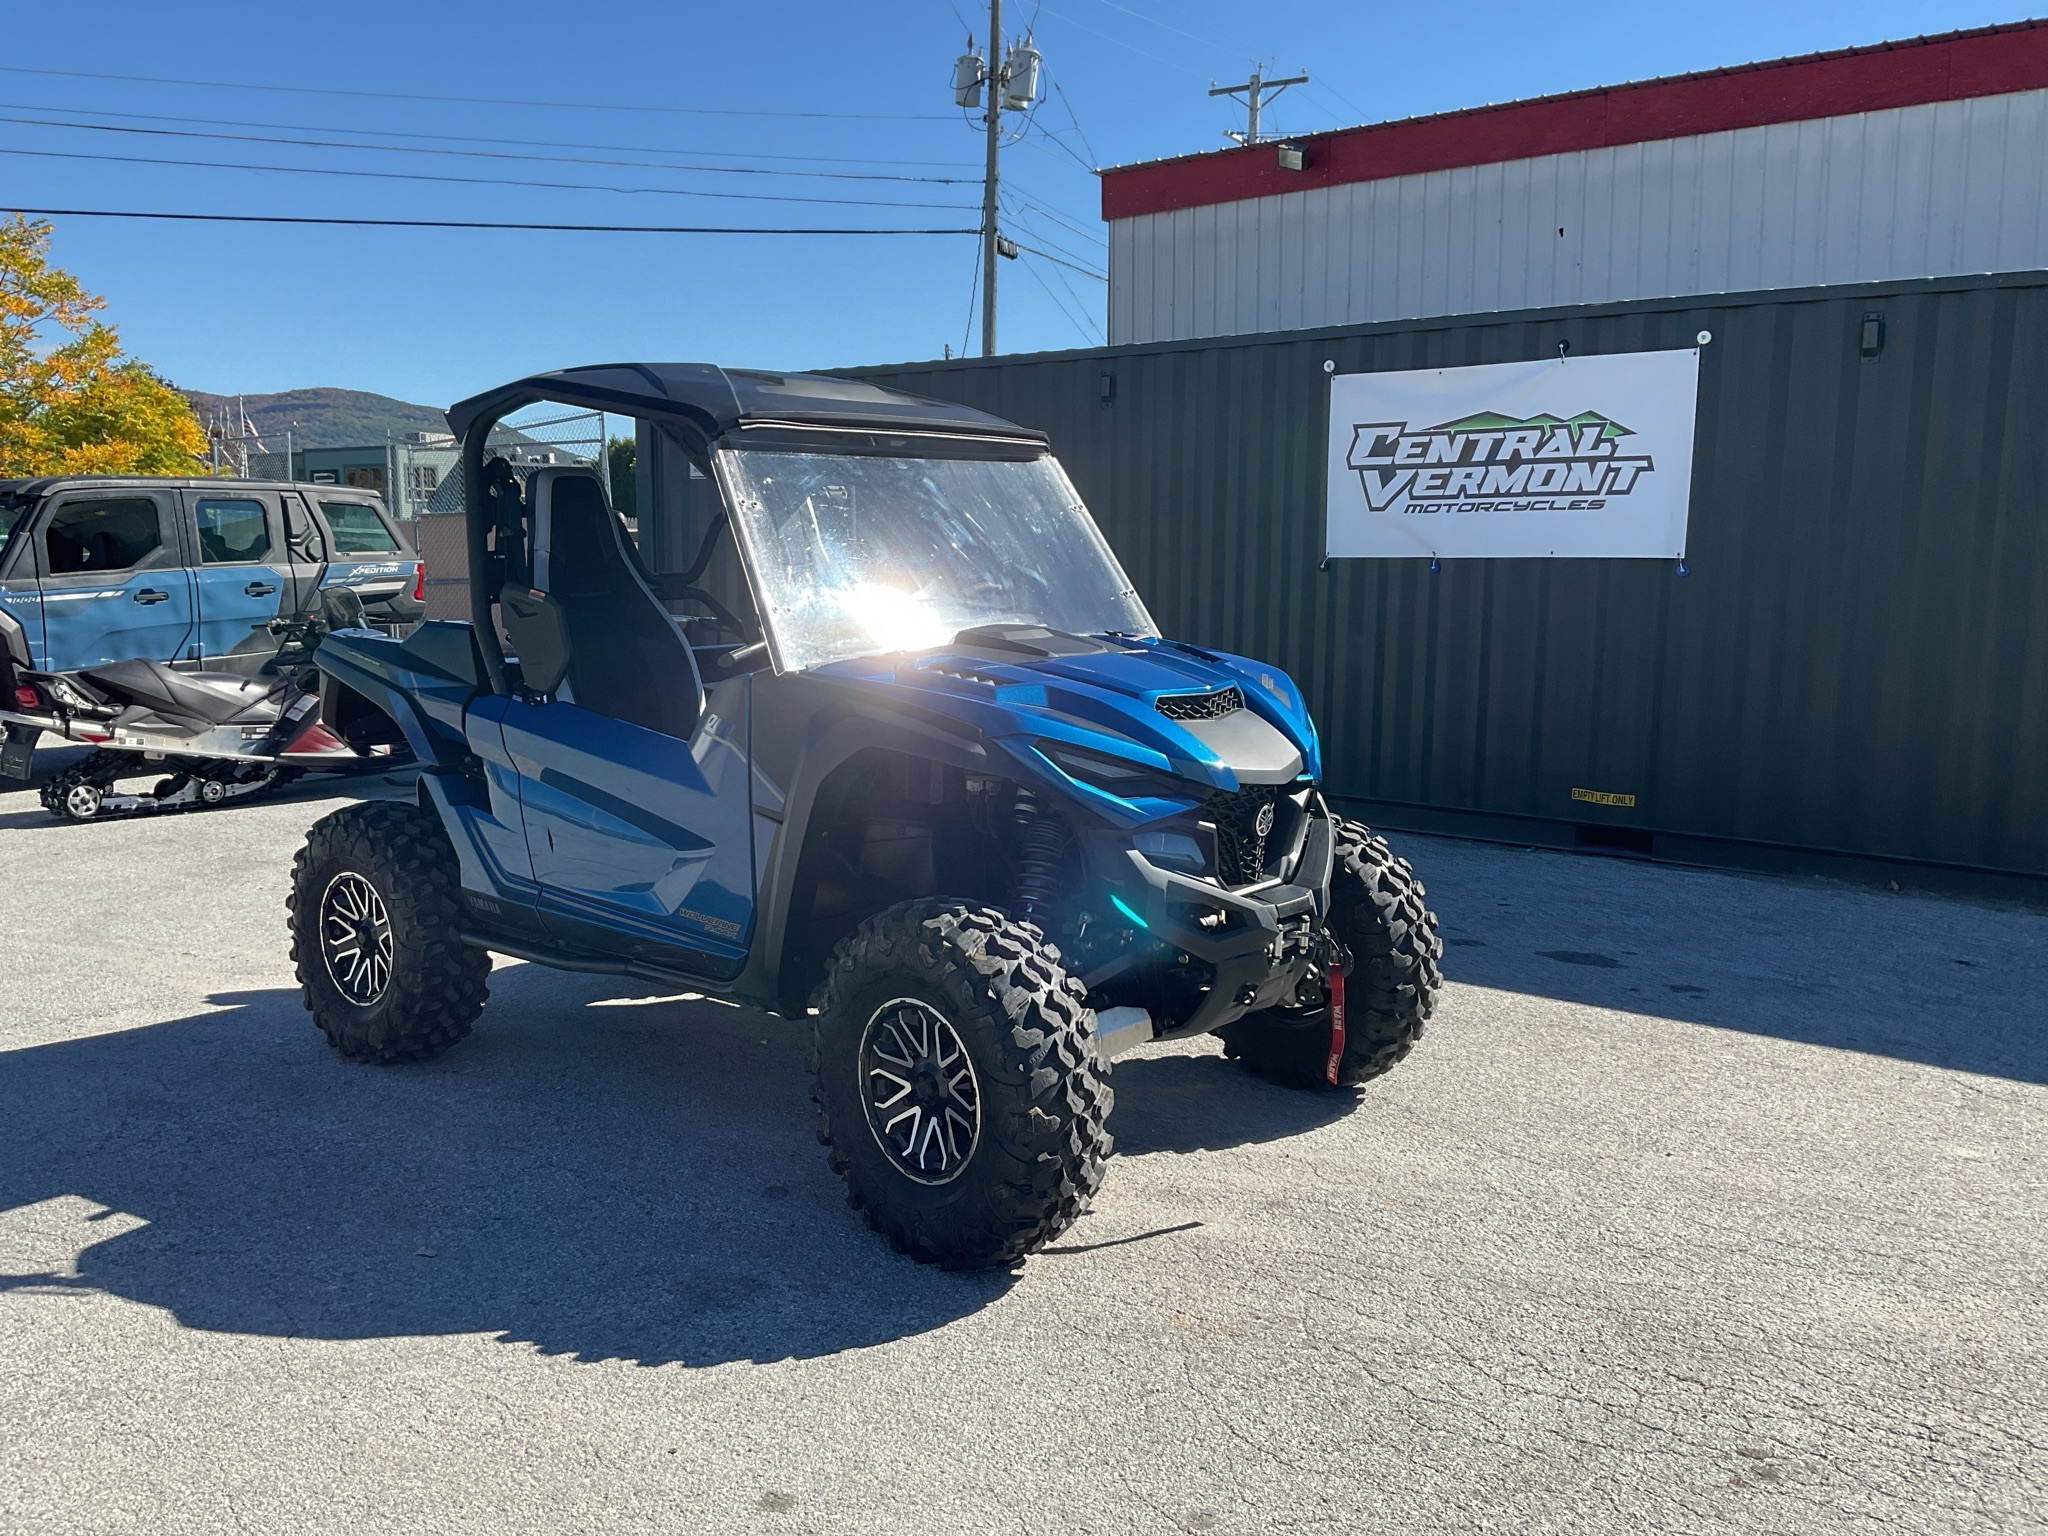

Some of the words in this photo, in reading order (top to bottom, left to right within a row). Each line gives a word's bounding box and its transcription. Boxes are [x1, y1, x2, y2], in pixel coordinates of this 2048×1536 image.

[1347, 421, 1613, 468] CENTRAL
[1359, 459, 1653, 510] VERMONT
[1404, 499, 1606, 514] MOTORCYCLES
[348, 565, 399, 577] XPEDITION
[1572, 789, 1595, 801] EMPTY
[1595, 793, 1611, 804] LIFT
[1611, 795, 1634, 806] ONLY
[467, 895, 503, 916] YAMAHA
[1333, 1005, 1343, 1031] WARN
[1328, 1053, 1340, 1080] WARN
